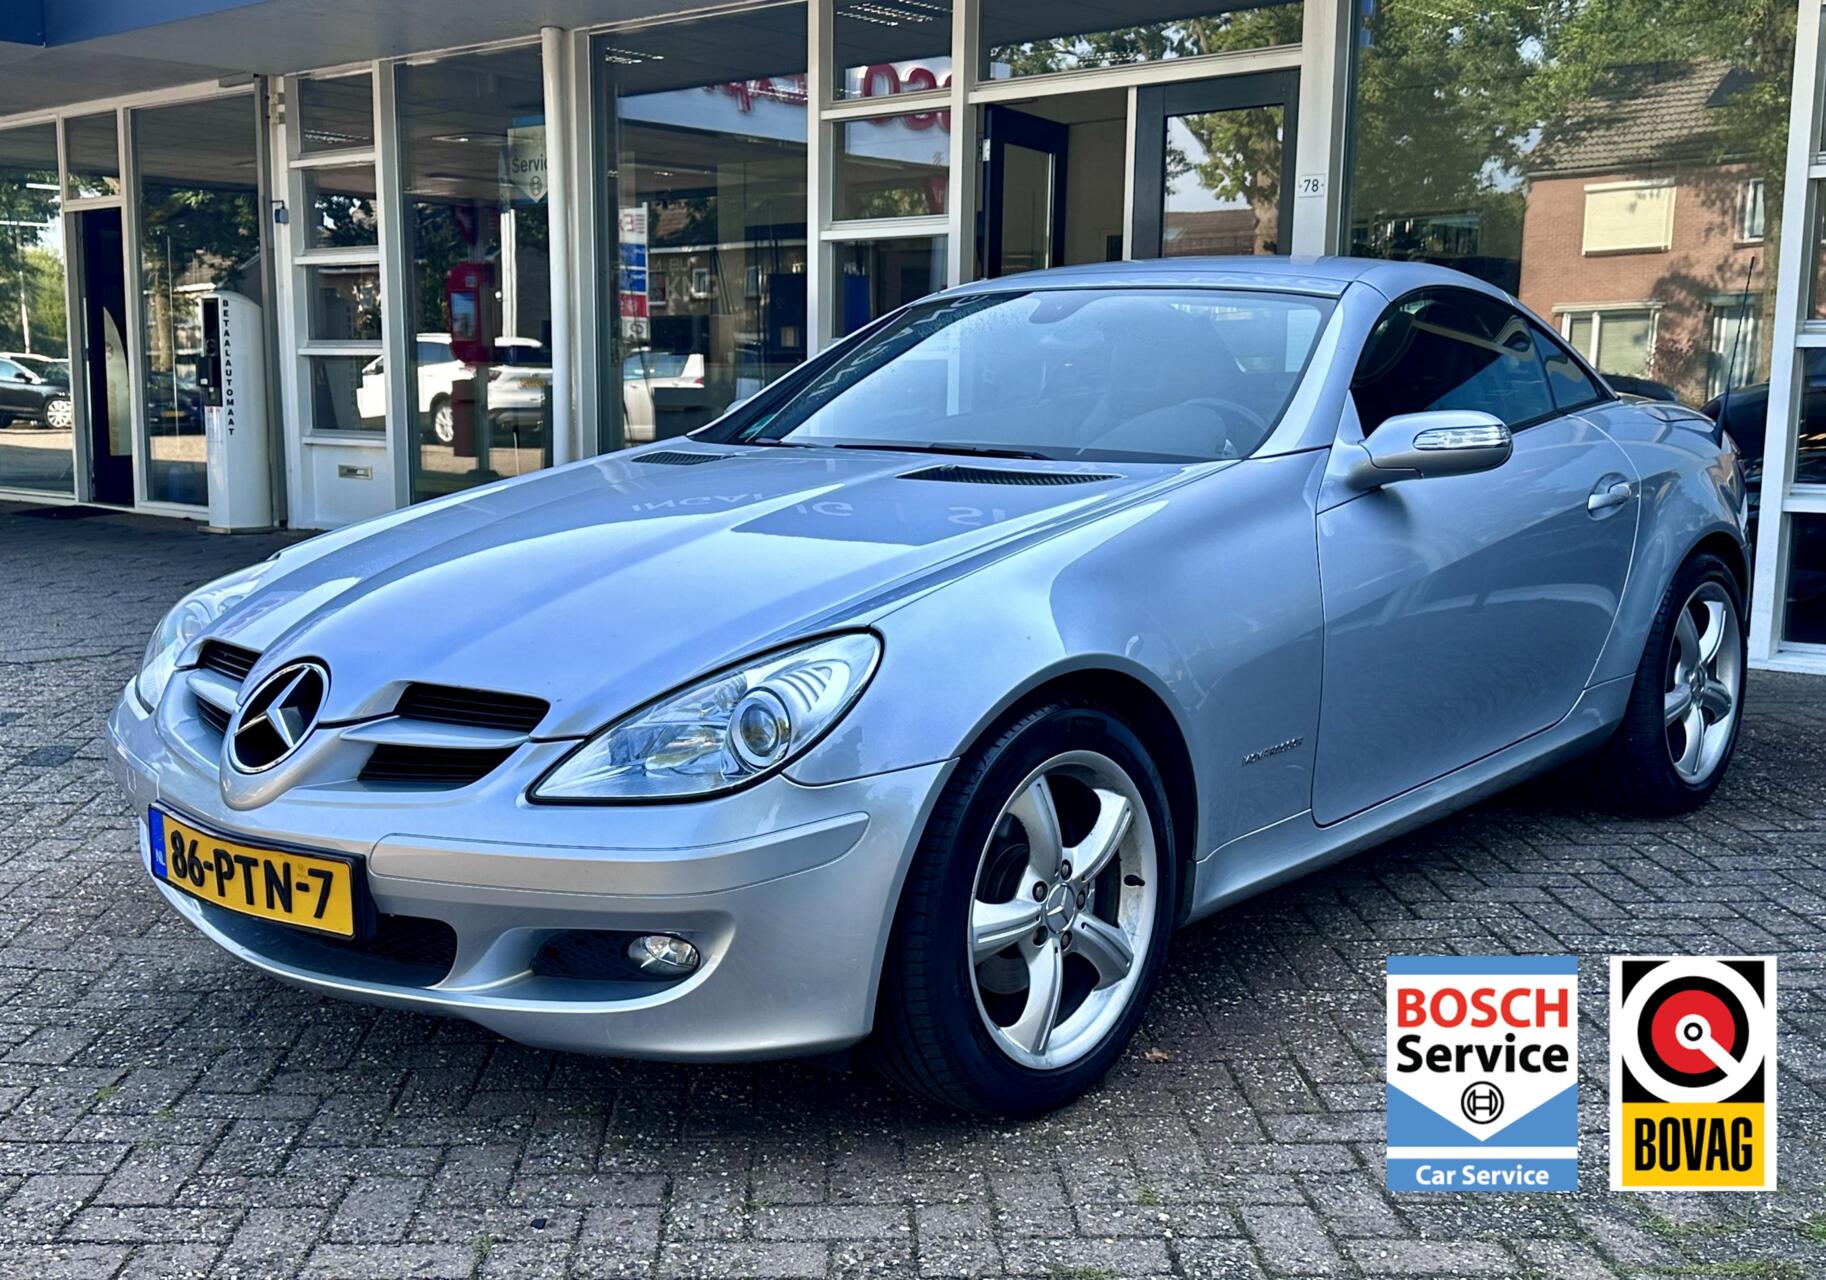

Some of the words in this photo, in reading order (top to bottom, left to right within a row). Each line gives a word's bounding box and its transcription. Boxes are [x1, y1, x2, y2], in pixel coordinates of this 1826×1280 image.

[1303, 178, 1320, 193] 78
[222, 299, 235, 436] BETAALAUTOMAAT
[155, 848, 166, 867] NL
[170, 829, 334, 920] 86-PTN-7
